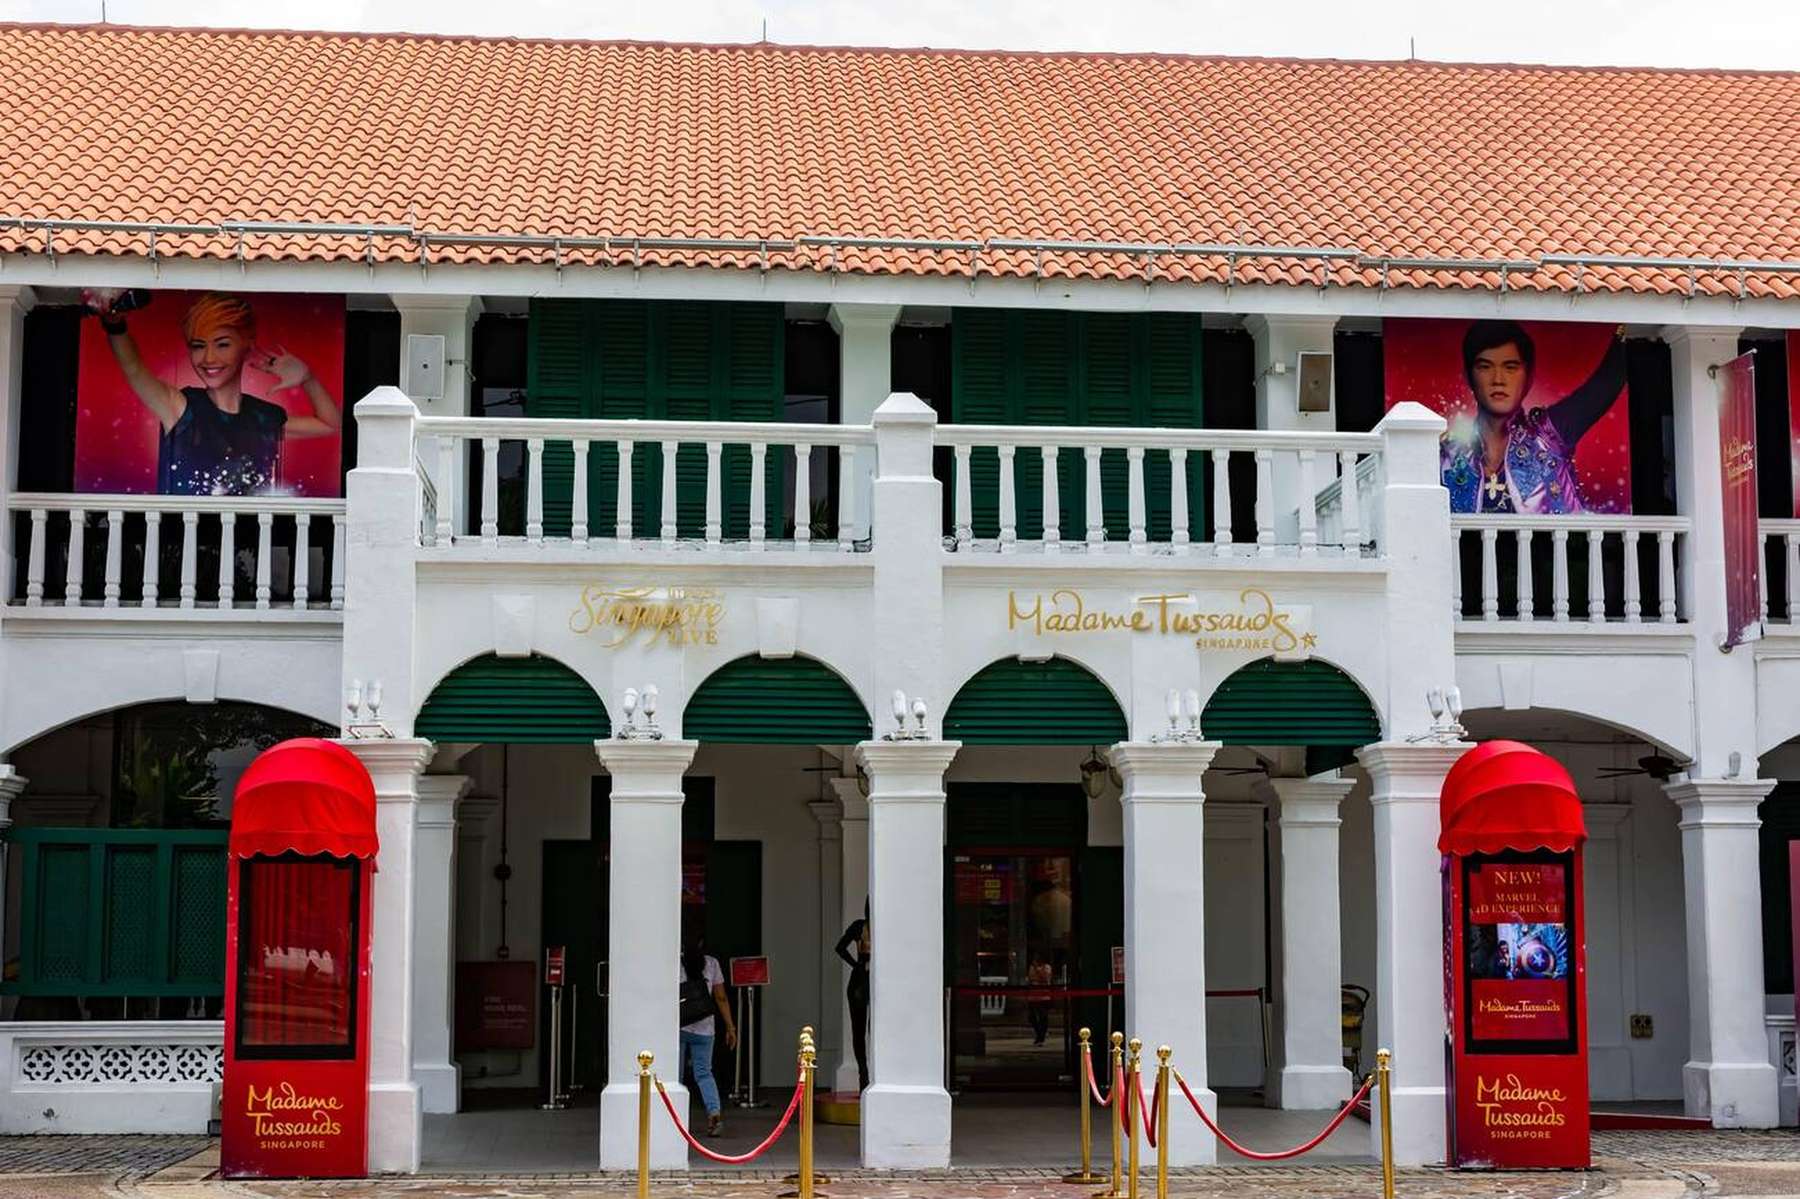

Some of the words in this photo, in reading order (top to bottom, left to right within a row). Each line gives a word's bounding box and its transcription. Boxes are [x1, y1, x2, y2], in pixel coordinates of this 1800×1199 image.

[569, 584, 728, 648] Singapore
[1008, 588, 1150, 635] Madame
[1138, 588, 1297, 651] Tussauds
[1196, 637, 1270, 649] SINGAPORE
[1494, 871, 1541, 885] NEW!
[1496, 893, 1538, 902] MARVEL
[1491, 903, 1560, 913] EXPERIENCE
[1479, 998, 1520, 1012] Madame
[1519, 999, 1560, 1012] Tussauds
[1477, 1073, 1567, 1102] Madame
[247, 1081, 344, 1111] Madame
[1476, 1101, 1566, 1127] Tussauds
[245, 1109, 342, 1137] Tussauds
[1490, 1130, 1552, 1139] SINGAPORE
[260, 1140, 326, 1149] SINGAPORE
